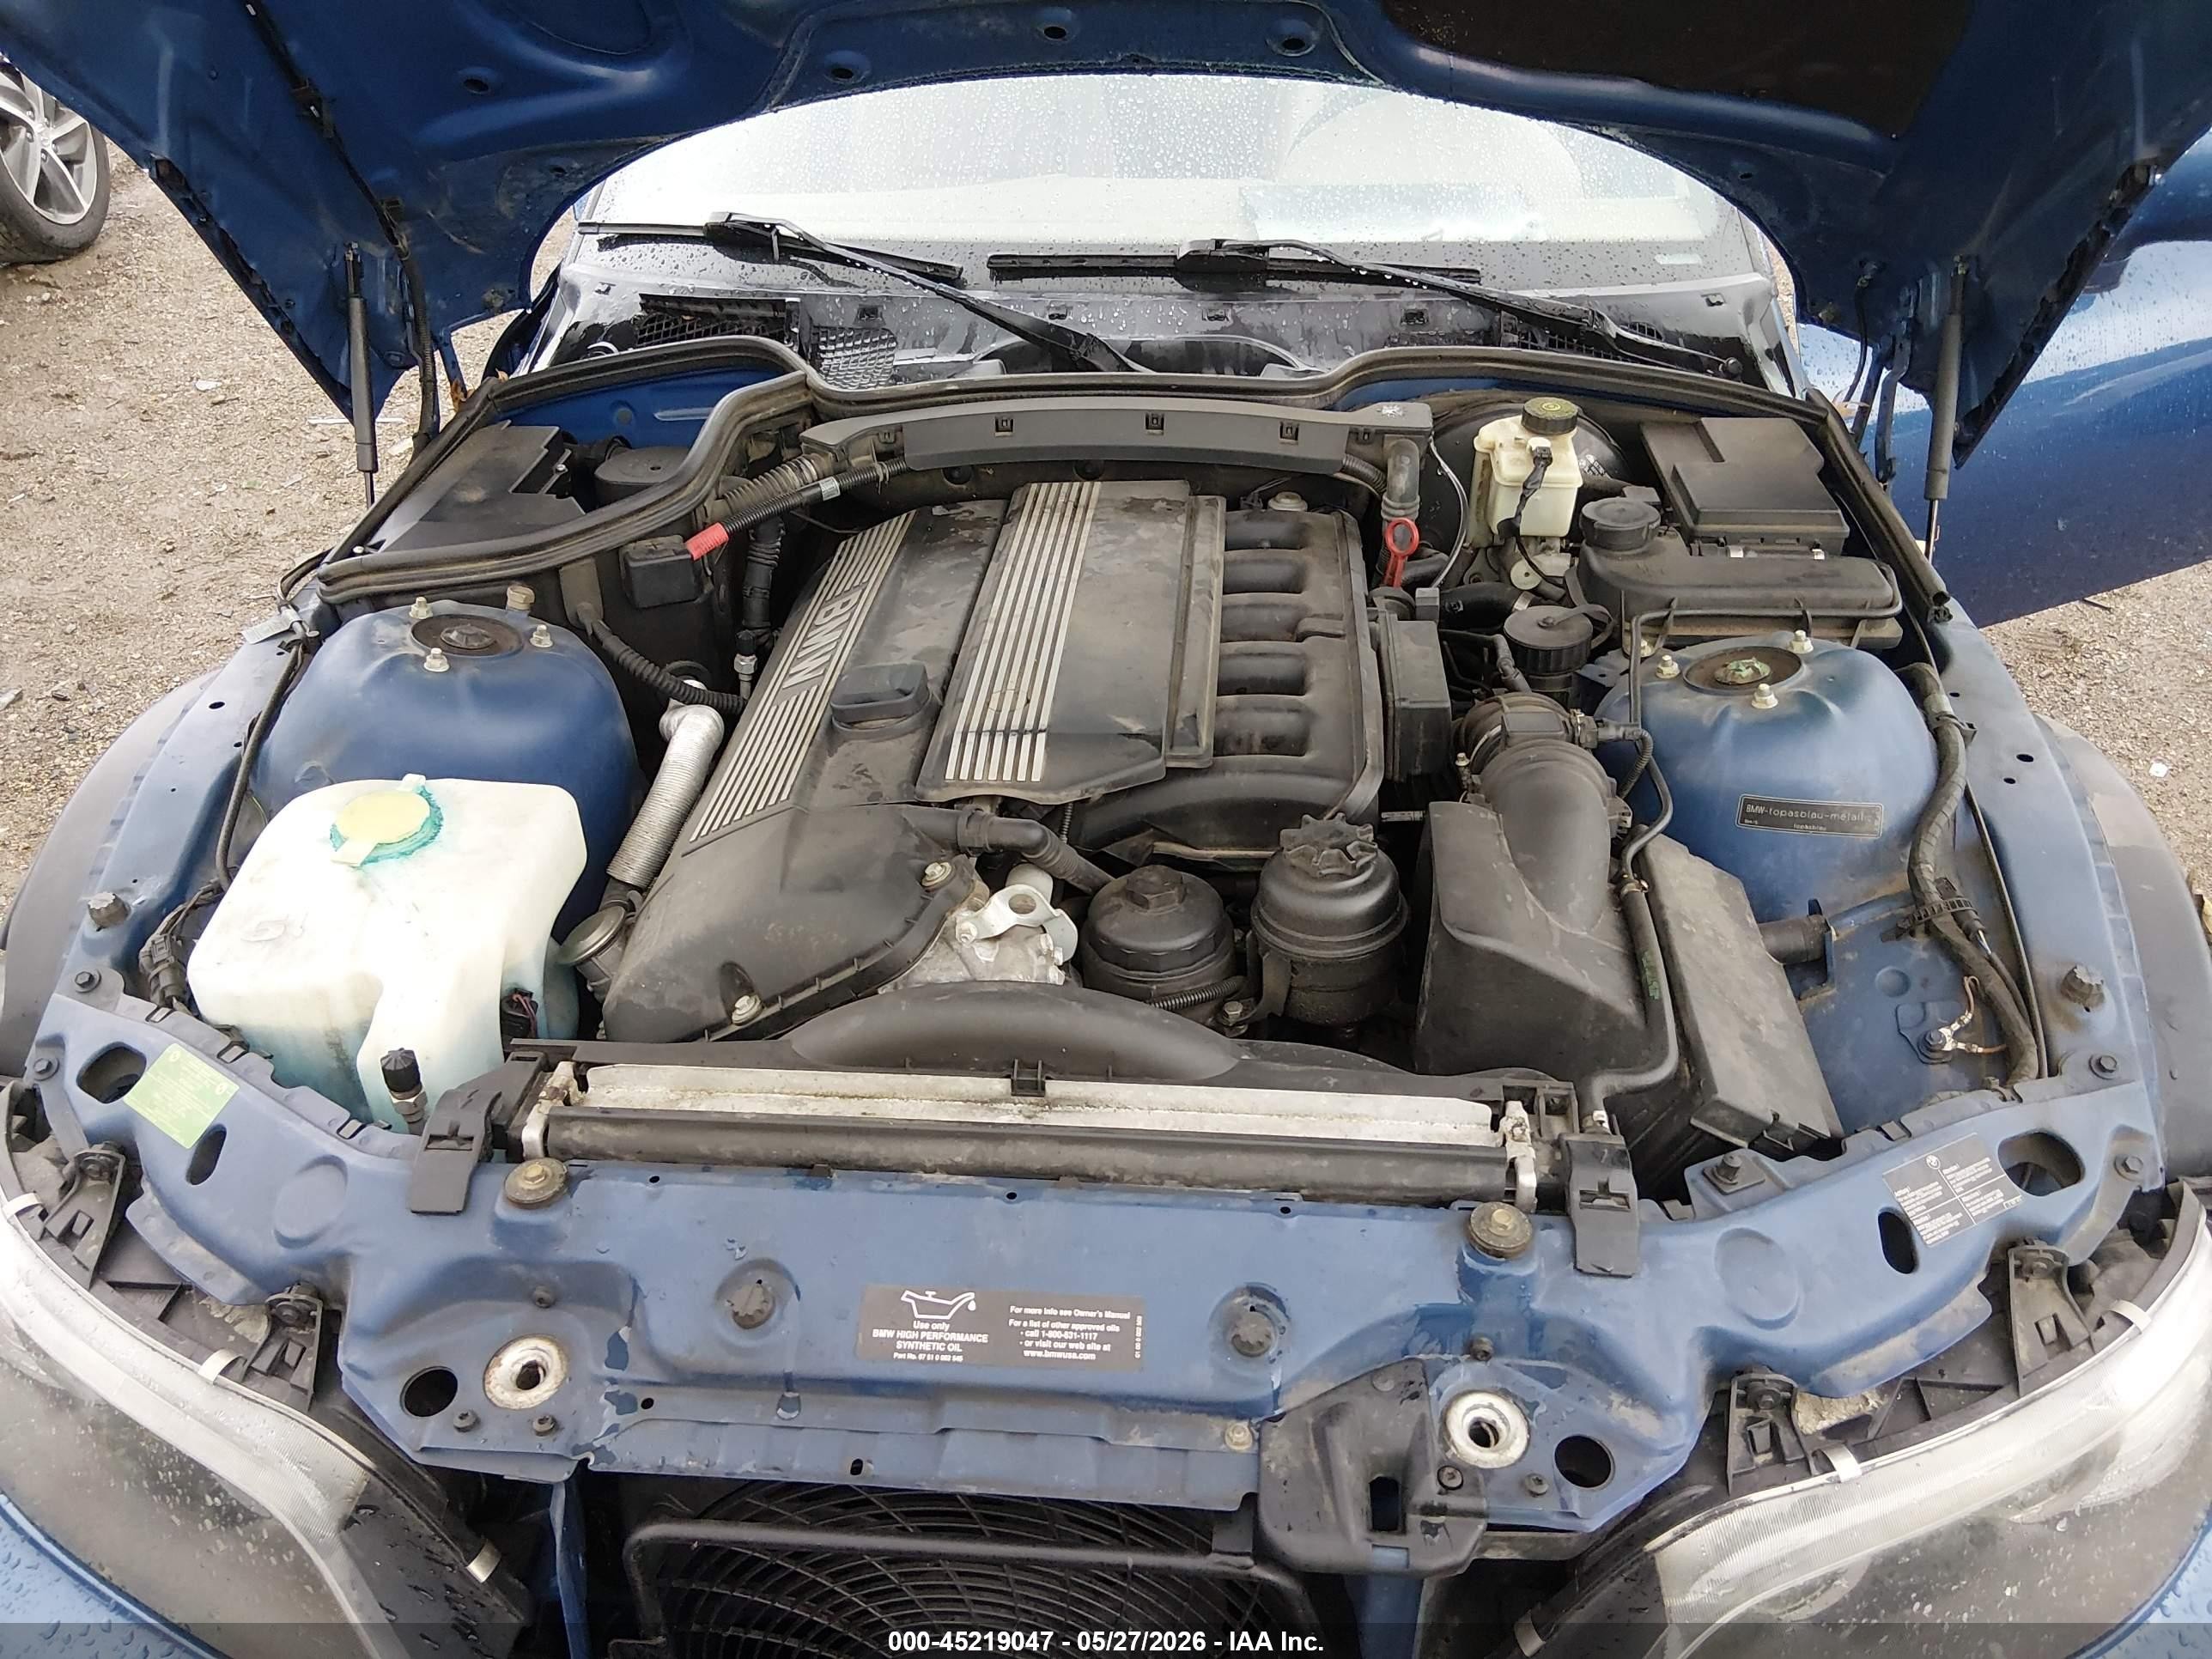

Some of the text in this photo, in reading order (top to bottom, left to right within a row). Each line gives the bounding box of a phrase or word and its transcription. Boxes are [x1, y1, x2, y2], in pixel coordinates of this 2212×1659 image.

[781, 589, 863, 690] BMW
[1010, 1305, 1023, 1314] For
[1043, 1307, 1059, 1316] info
[1073, 1309, 1103, 1318] Owner's
[1104, 1310, 1131, 1319] Manual
[913, 1321, 950, 1332] Use only
[1008, 1318, 1022, 1327] For
[1029, 1319, 1041, 1328] list
[1042, 1320, 1050, 1328] of
[1050, 1321, 1071, 1329] other
[1106, 1323, 1120, 1332] oils
[872, 1328, 988, 1343] BMW HIGH PERFORMANCE
[1024, 1328, 1040, 1338] call
[896, 1340, 963, 1352] SYNTHETIC OIL
[1035, 1339, 1052, 1348] visit
[1068, 1341, 1085, 1350] web
[1086, 1341, 1102, 1351] site
[1102, 1343, 1111, 1352] at
[1023, 1349, 1096, 1360] www.bmwusa.com
